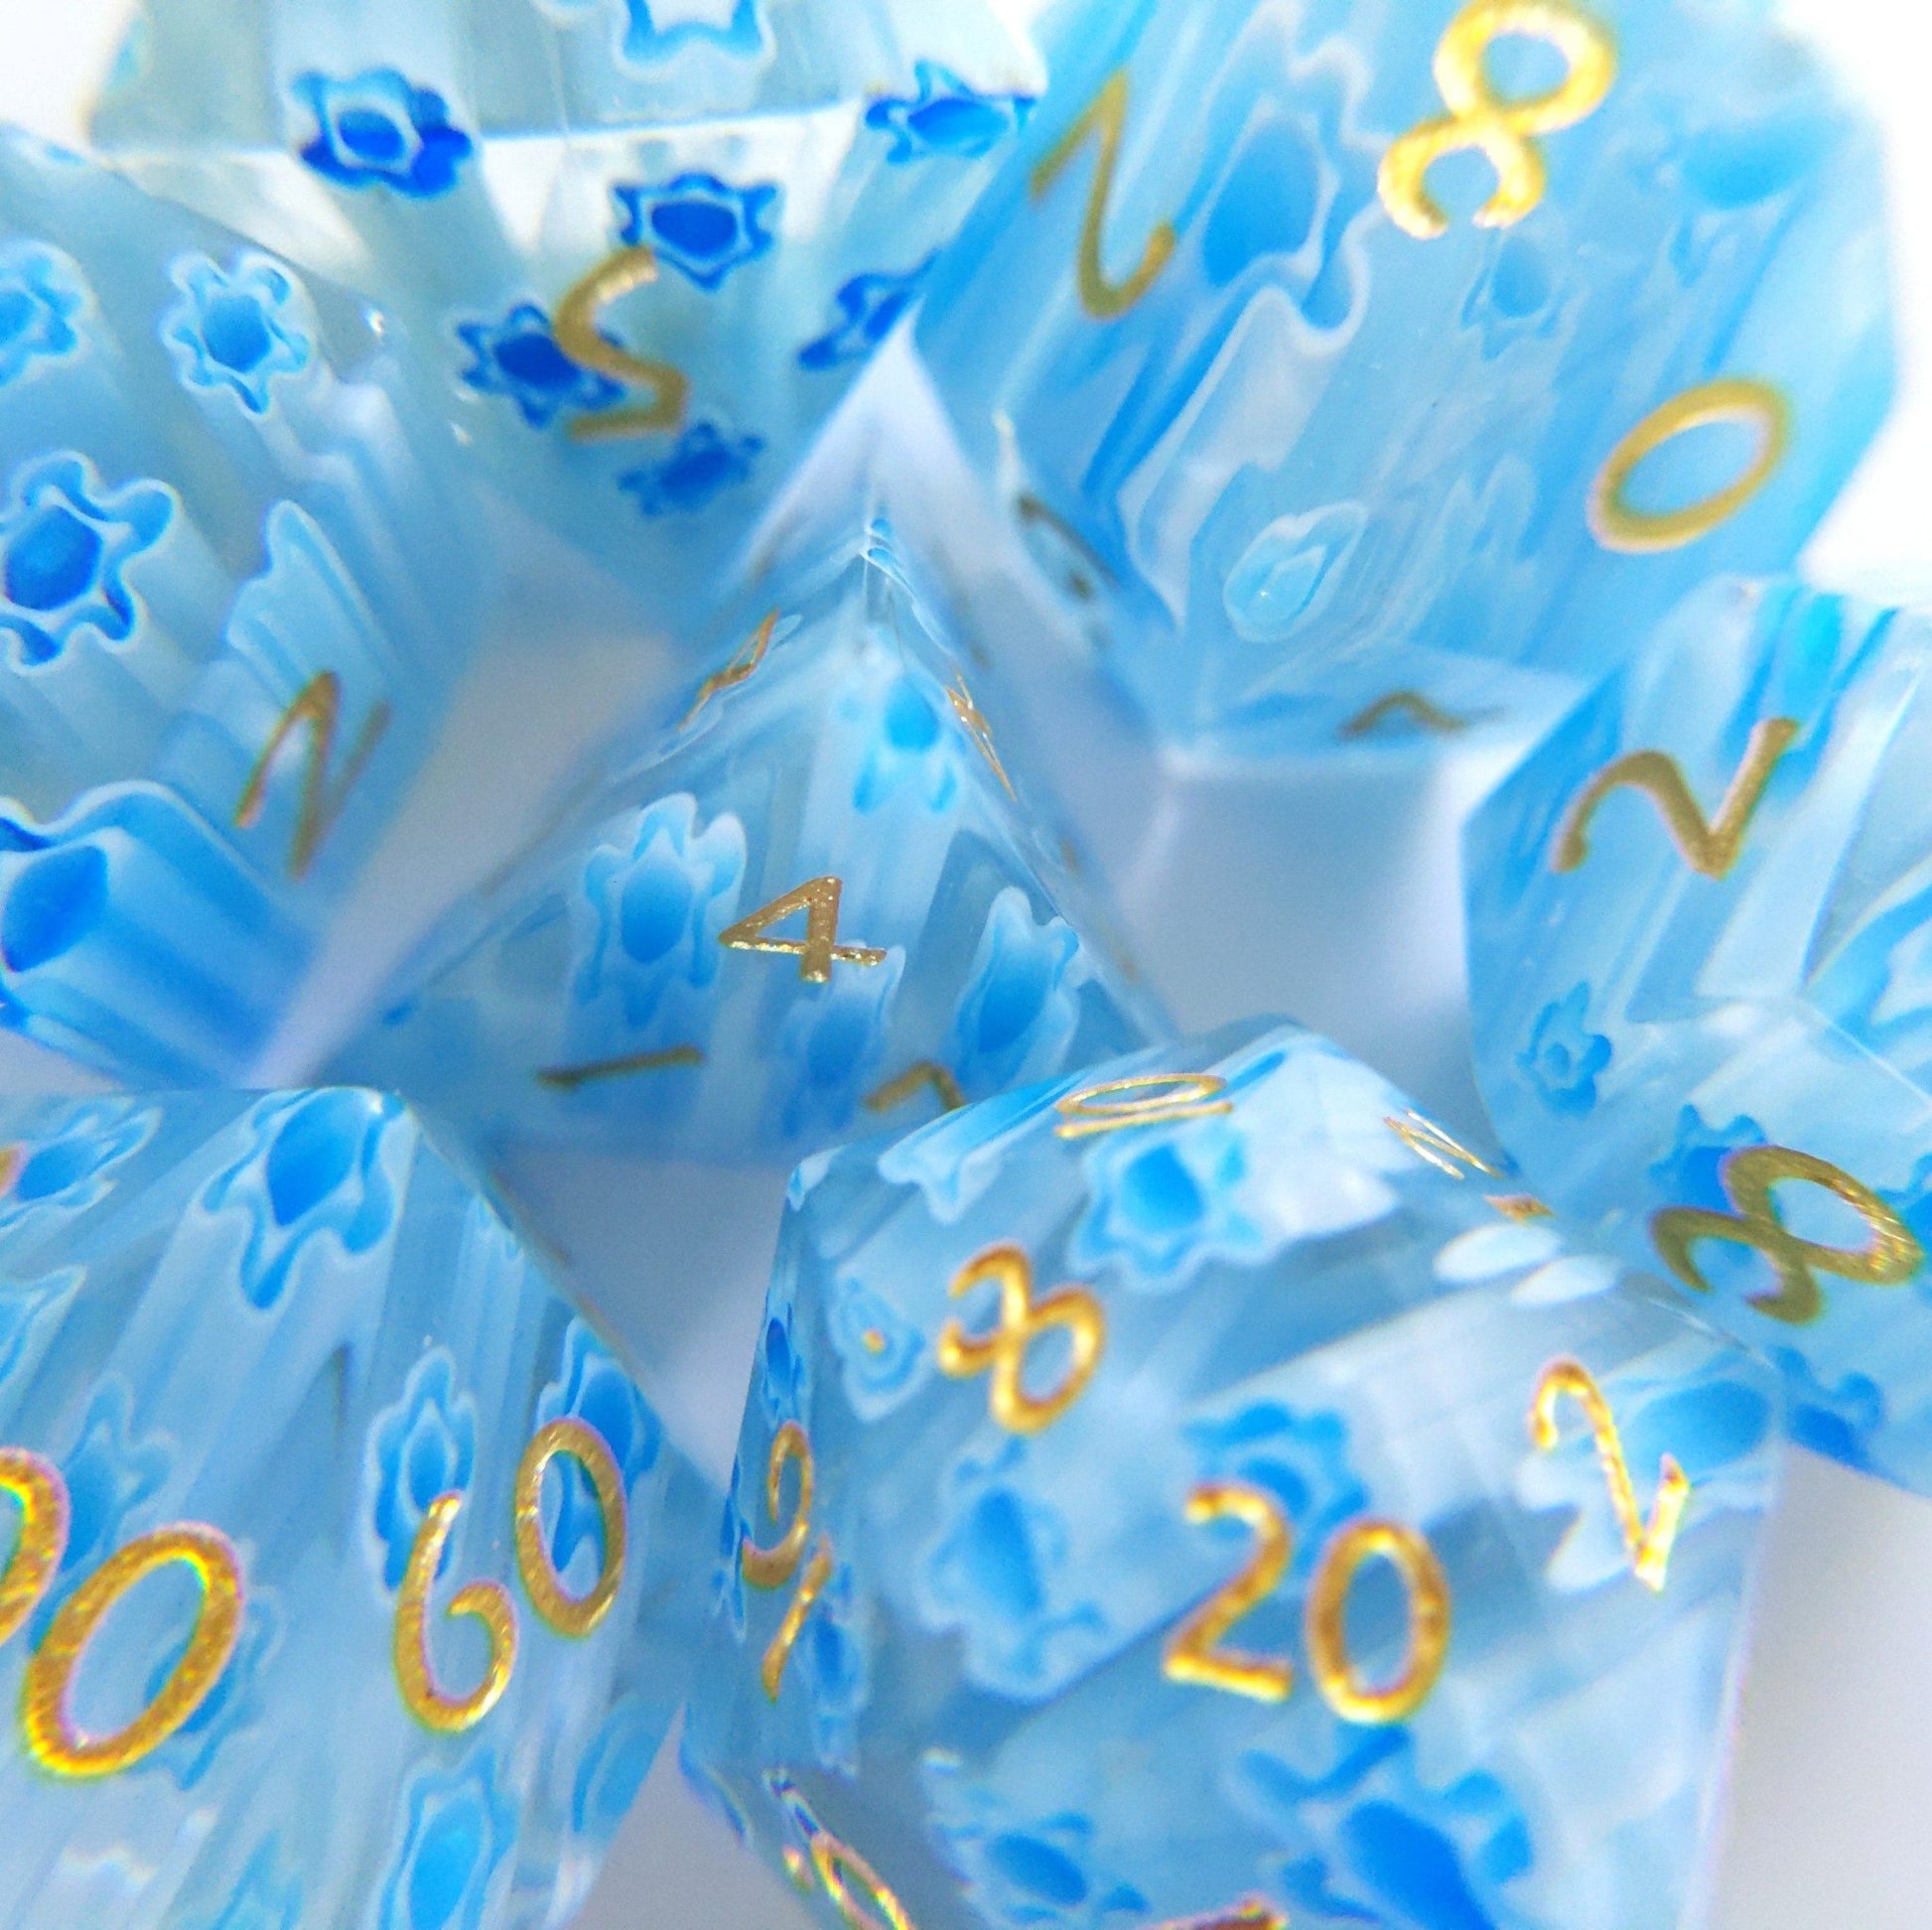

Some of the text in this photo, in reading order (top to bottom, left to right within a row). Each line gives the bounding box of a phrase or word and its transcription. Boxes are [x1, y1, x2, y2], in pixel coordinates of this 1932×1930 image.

[1378, 0, 1618, 239] 8
[1588, 375, 1797, 553] 0
[1549, 717, 1799, 882] 2
[718, 875, 888, 984] 4
[1650, 1144, 1924, 1324] 8
[936, 1243, 1106, 1436] 8
[1527, 1354, 1690, 1594] 2
[393, 1417, 627, 1733] 60
[1162, 1479, 1451, 1725] 20
